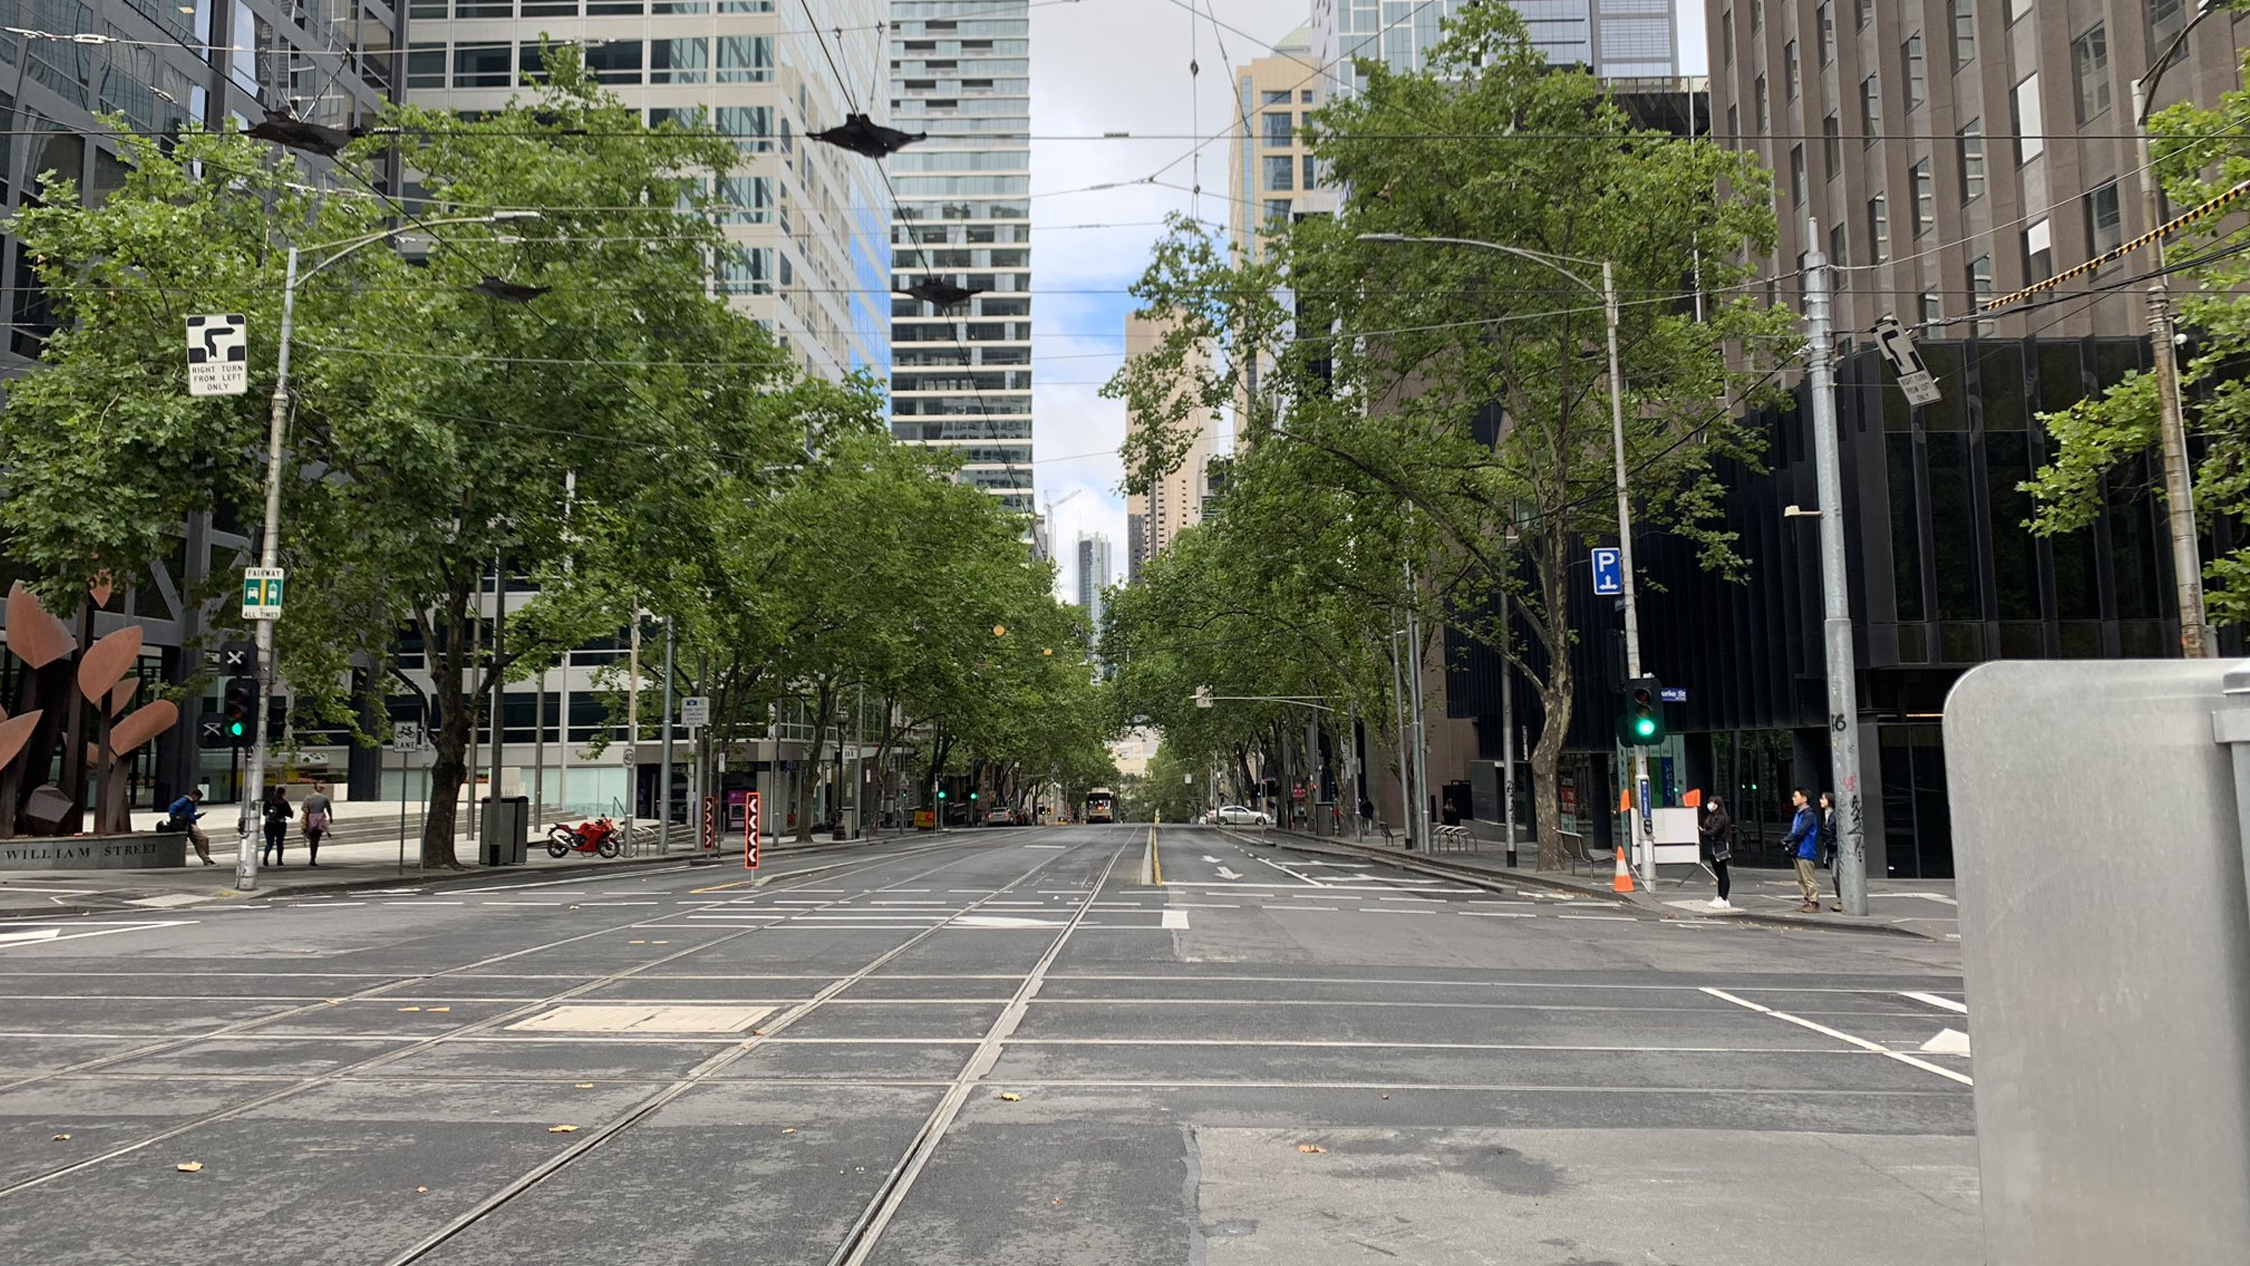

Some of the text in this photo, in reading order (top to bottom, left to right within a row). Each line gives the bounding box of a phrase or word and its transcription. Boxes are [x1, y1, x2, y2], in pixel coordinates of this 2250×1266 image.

[192, 366, 216, 374] RIGHT
[207, 383, 229, 391] ONLY
[1598, 552, 1616, 572] P
[247, 569, 281, 577] FAIRWAY
[1661, 690, 1677, 698] urke
[395, 741, 415, 749] LANE
[6, 843, 156, 860] WILLIAM STREET
